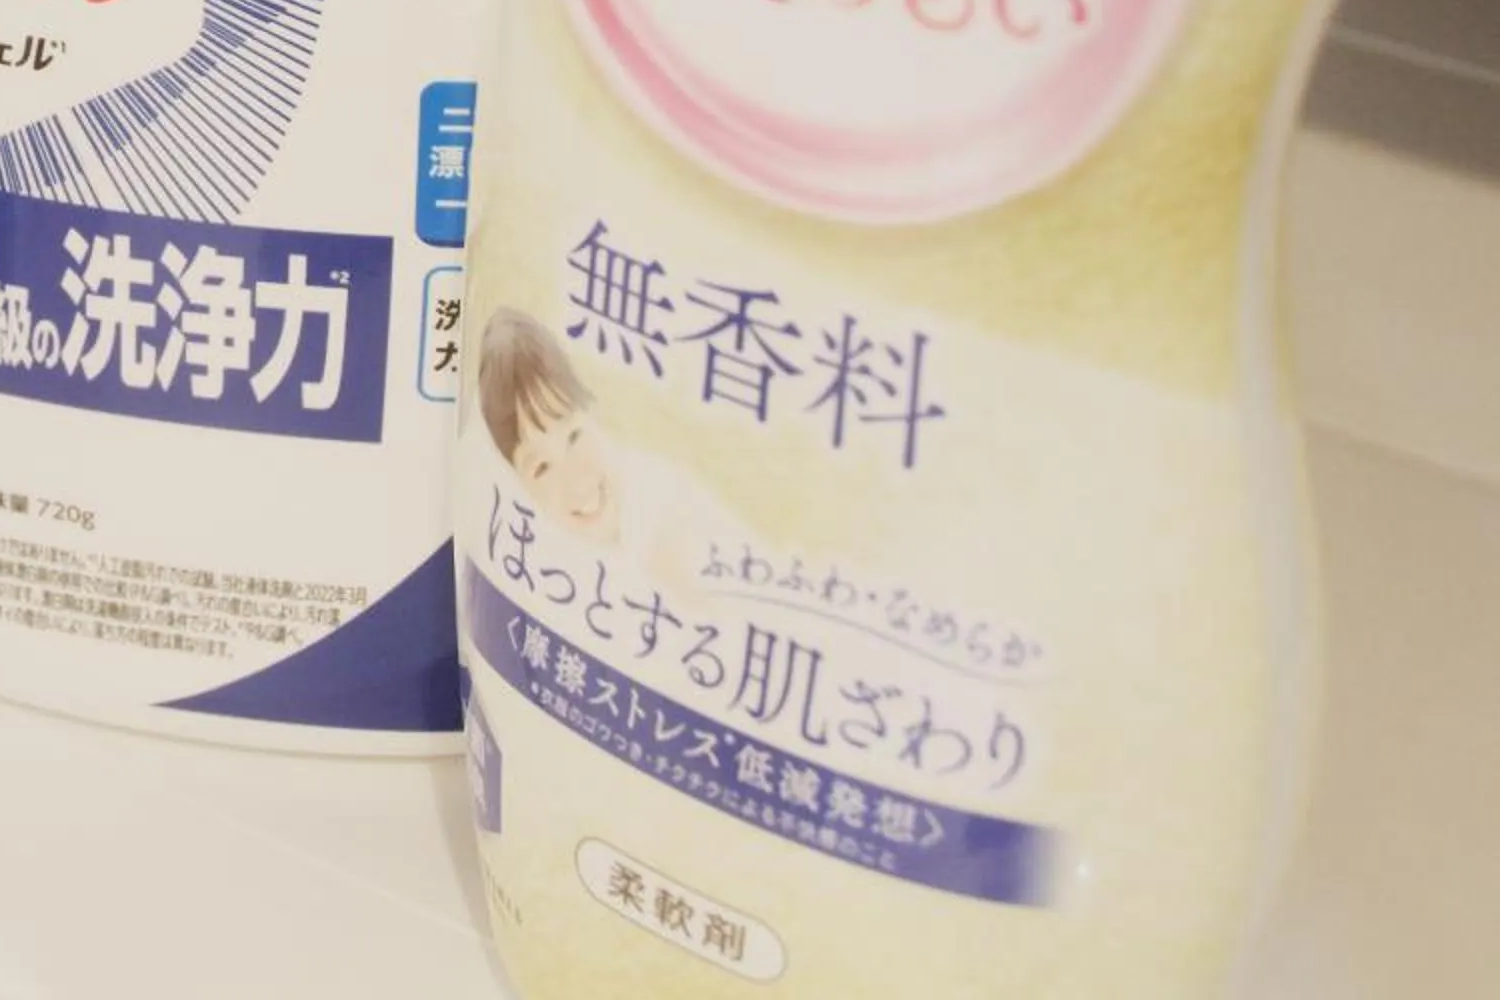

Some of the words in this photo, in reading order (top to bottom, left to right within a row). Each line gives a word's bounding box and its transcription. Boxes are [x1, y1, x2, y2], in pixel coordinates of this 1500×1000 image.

[566, 219, 947, 469] 無香料
[36, 497, 95, 531] 720g
[488, 483, 1026, 791] ほっとする肌ざわり
[700, 543, 1043, 668] ふわふわ・なめらか
[607, 860, 747, 962] 柔軟剤
